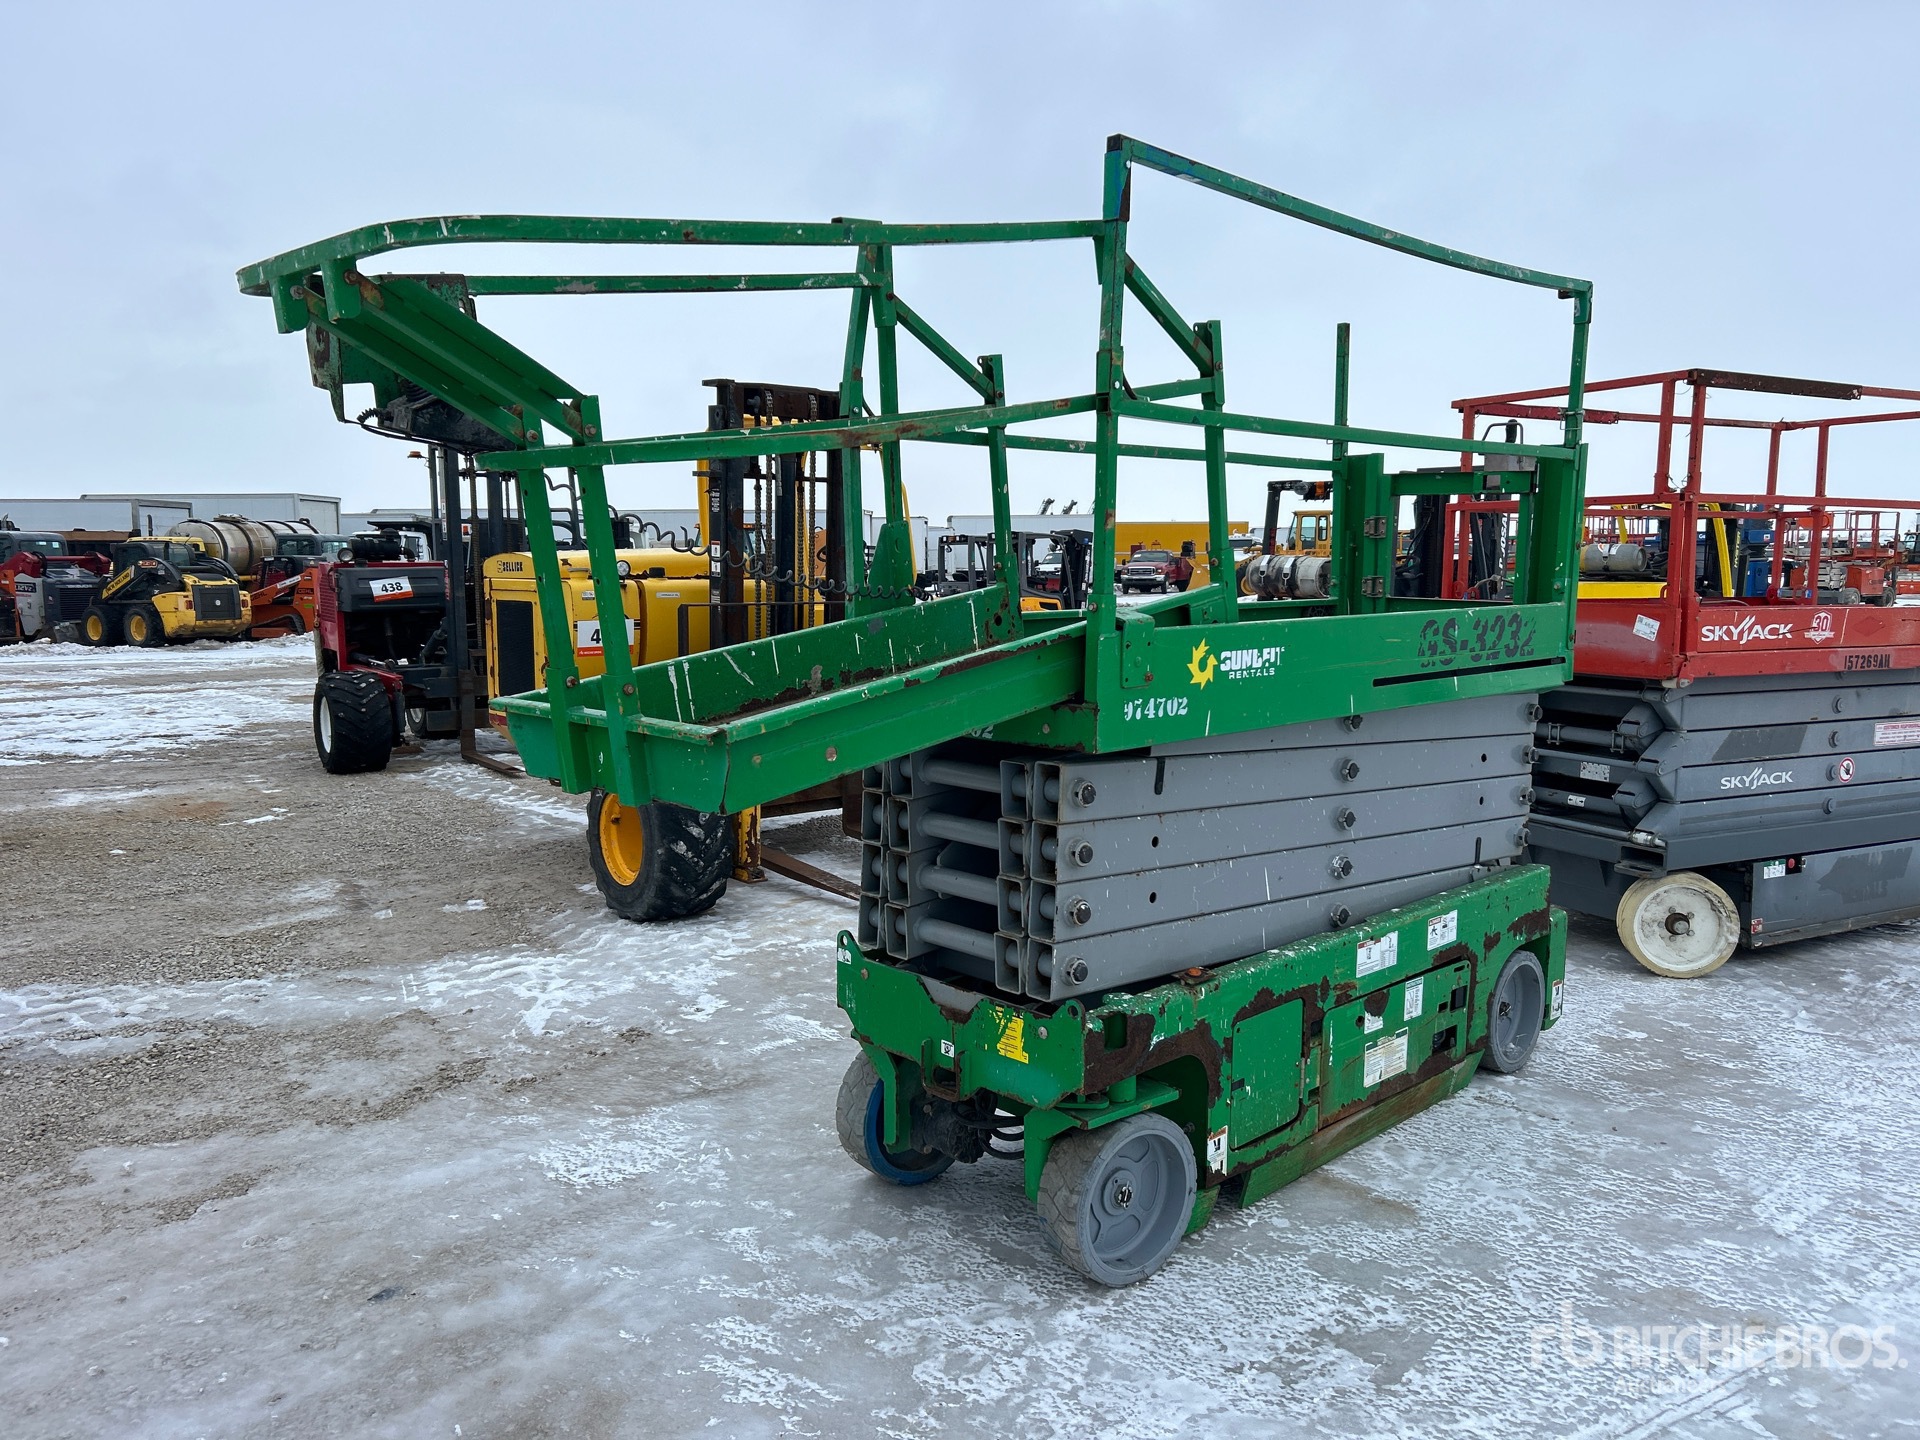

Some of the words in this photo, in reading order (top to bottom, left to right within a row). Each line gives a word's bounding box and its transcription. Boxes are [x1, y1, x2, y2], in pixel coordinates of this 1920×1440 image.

[502, 560, 524, 573] SELLICK
[381, 581, 404, 593] 438
[1418, 612, 1536, 668] GS-3232
[1701, 615, 1793, 644] SKYJACK
[1229, 667, 1276, 680] RENTALS
[1124, 696, 1189, 721] 974702
[1720, 767, 1793, 790] SKYJACK
